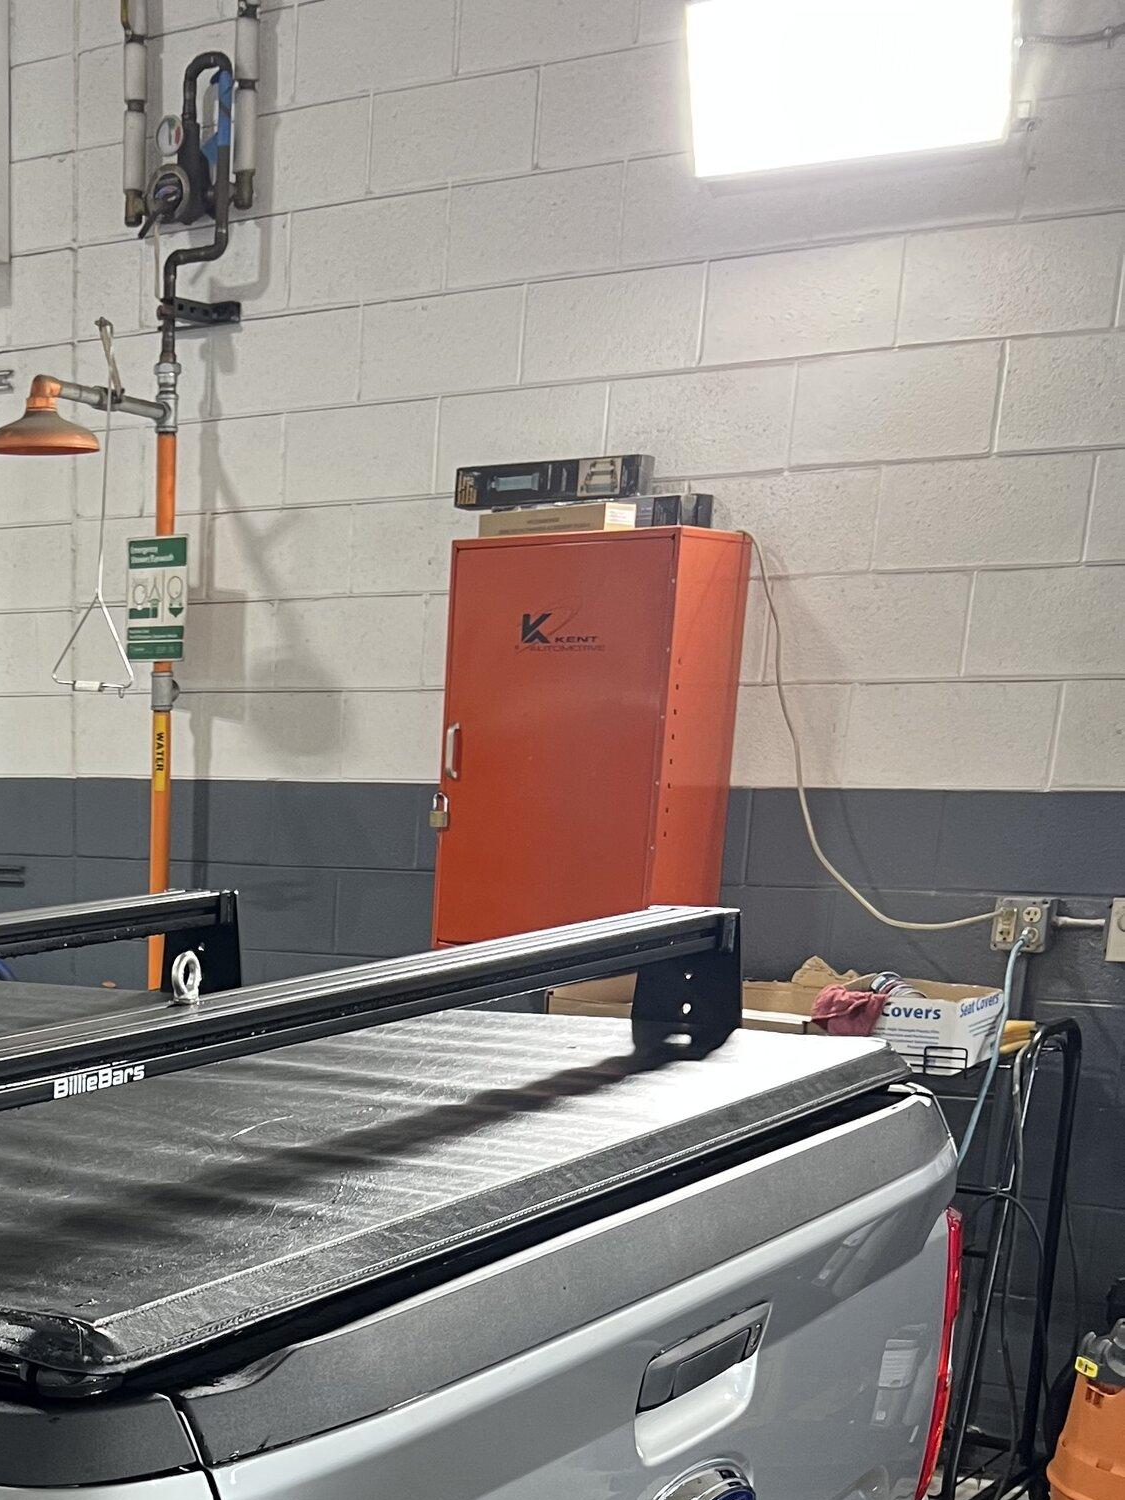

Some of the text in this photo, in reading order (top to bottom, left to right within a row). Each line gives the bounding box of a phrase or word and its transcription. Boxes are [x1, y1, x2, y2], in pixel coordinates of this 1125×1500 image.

[554, 635, 598, 643] KENT
[156, 731, 164, 772] WATER
[959, 994, 1001, 1018] Seat Covers
[53, 1064, 145, 1100] BillieBars
